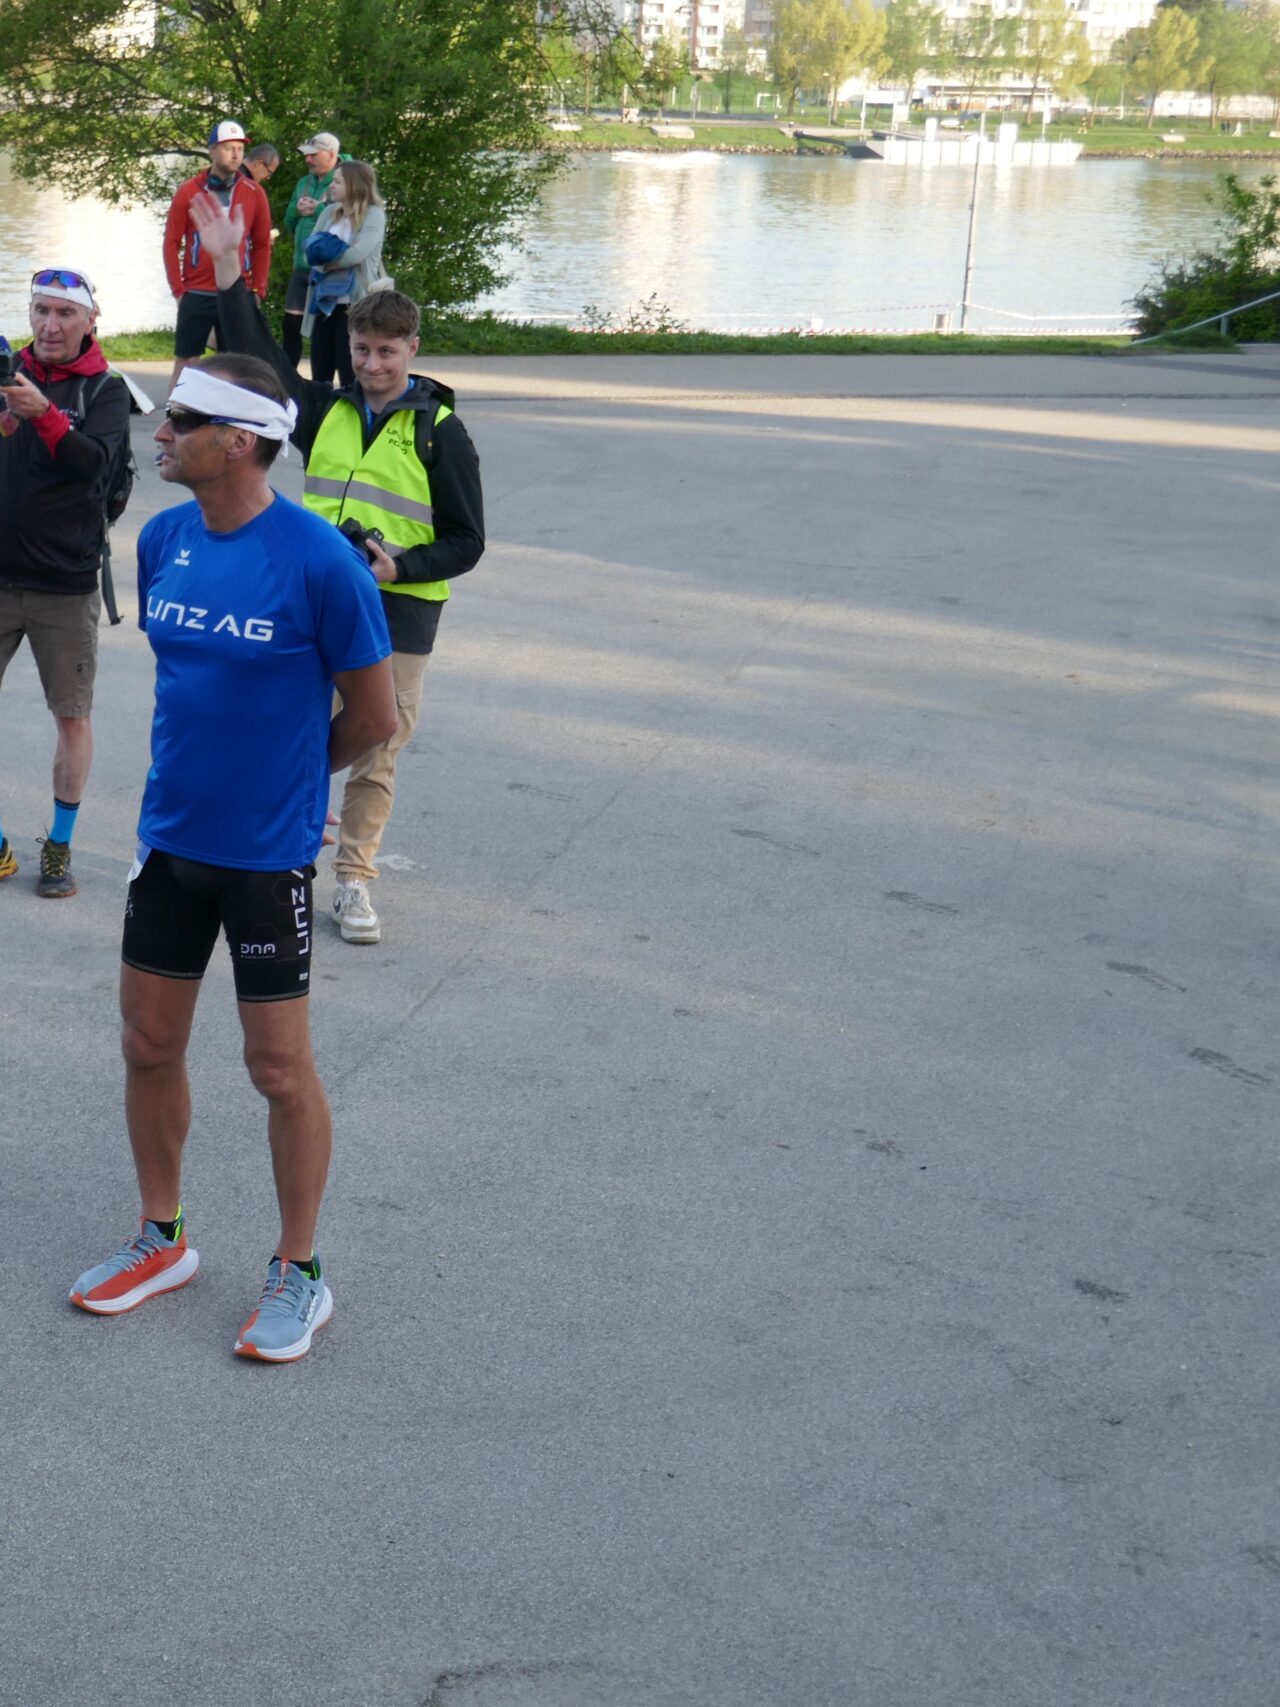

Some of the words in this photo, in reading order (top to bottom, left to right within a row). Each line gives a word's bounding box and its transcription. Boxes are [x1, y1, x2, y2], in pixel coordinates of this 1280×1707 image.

[146, 595, 208, 630] LINZ
[212, 613, 274, 642] AG
[291, 886, 310, 955] LINZ
[240, 943, 276, 954] DNA
